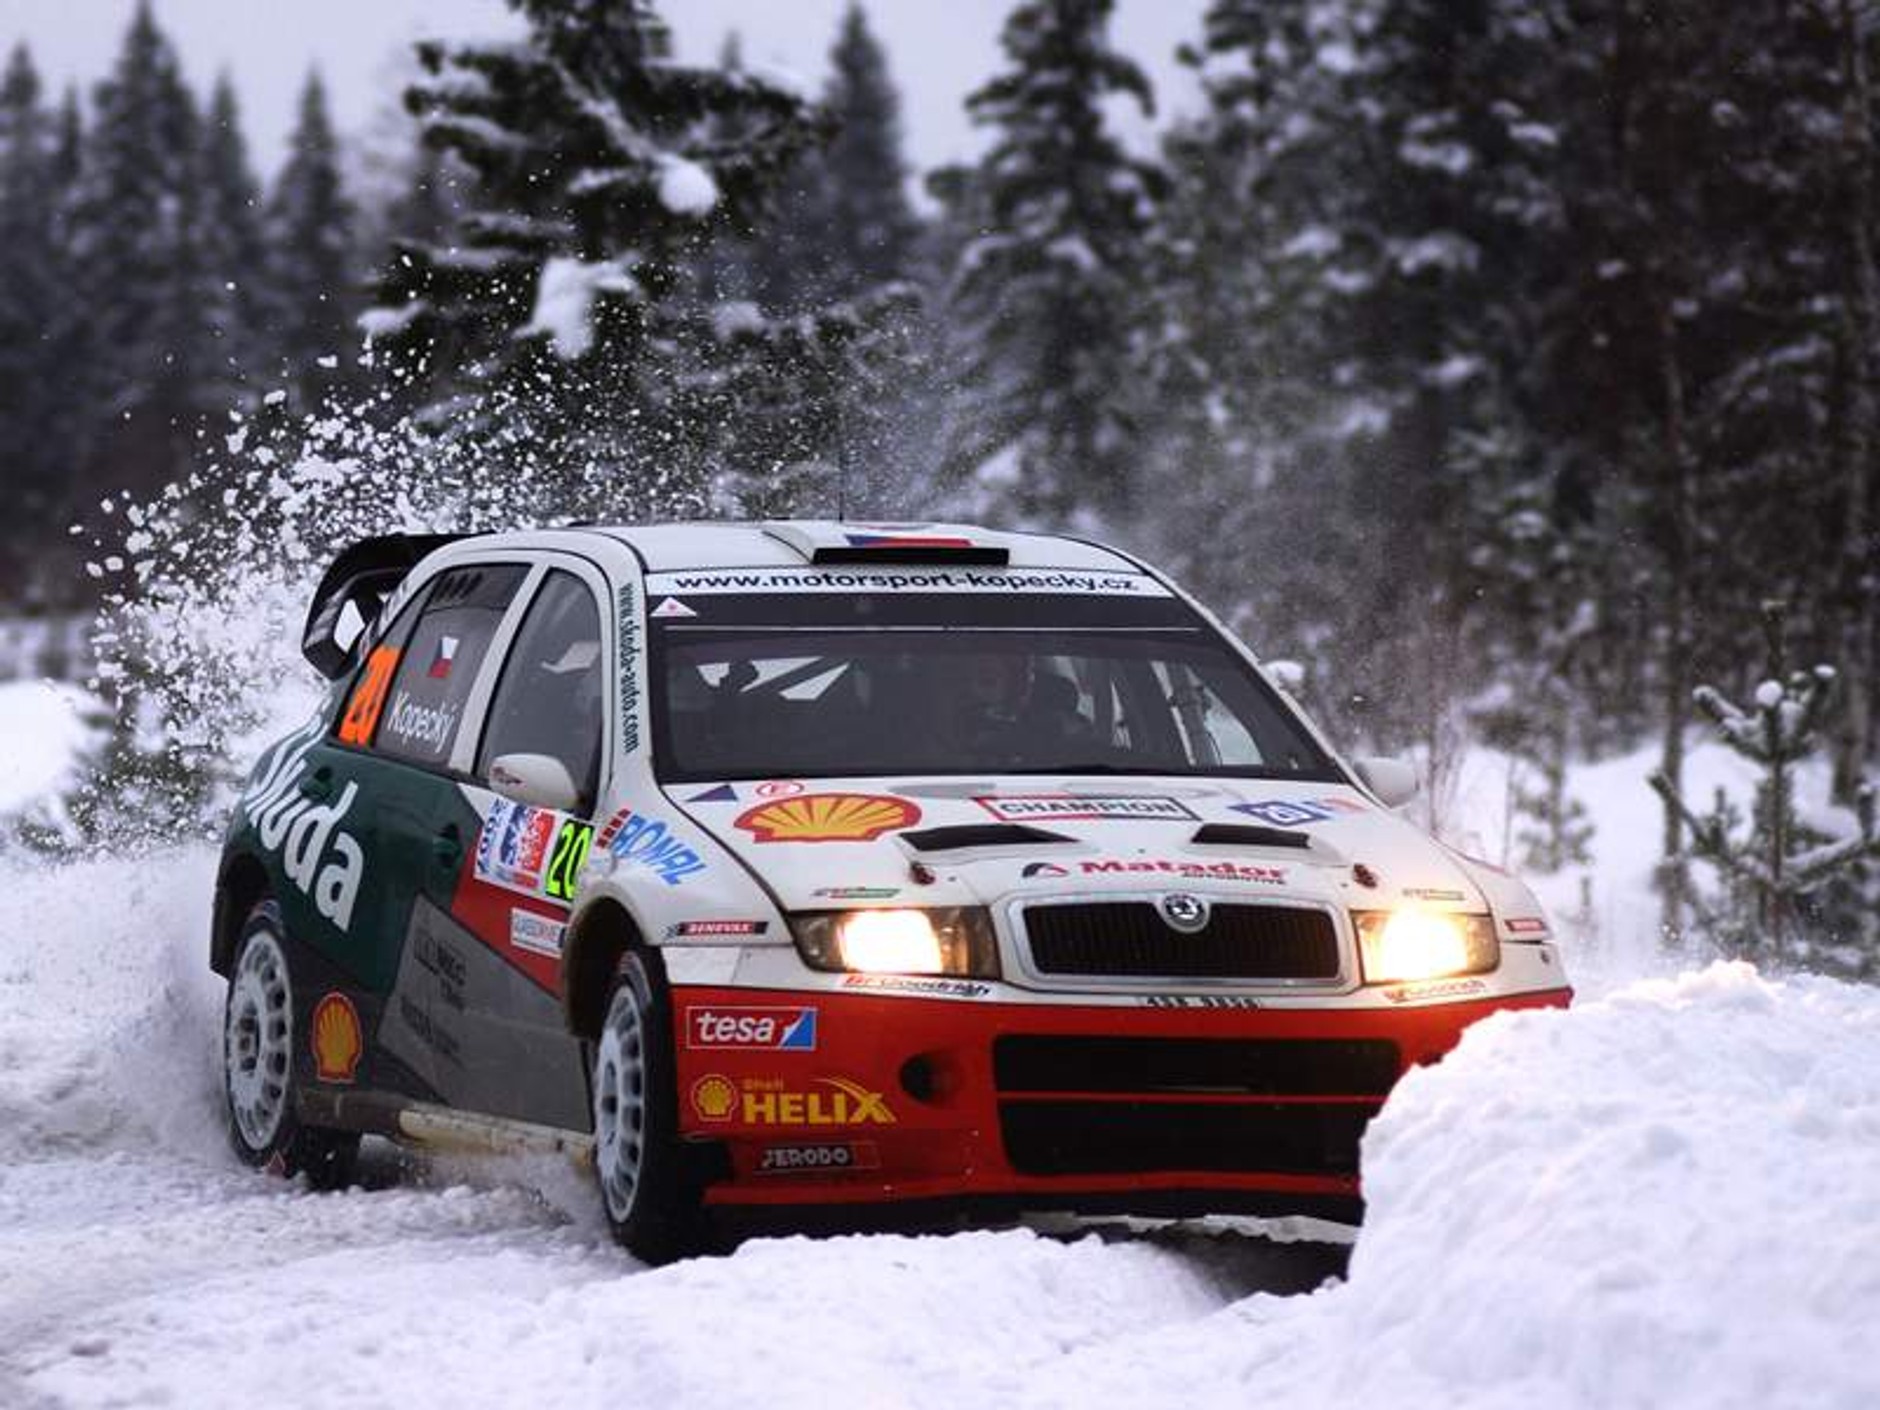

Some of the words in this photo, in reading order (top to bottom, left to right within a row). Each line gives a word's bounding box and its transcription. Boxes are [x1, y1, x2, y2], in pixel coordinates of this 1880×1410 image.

[675, 572, 1139, 591] www.motorsport-kopecky.cz
[619, 582, 641, 754] www.skoda-auto.com
[1000, 801, 1179, 814] CHAMPION
[1080, 860, 1289, 878] Matador
[697, 1012, 775, 1042] tesa
[742, 1092, 897, 1124] HELIX
